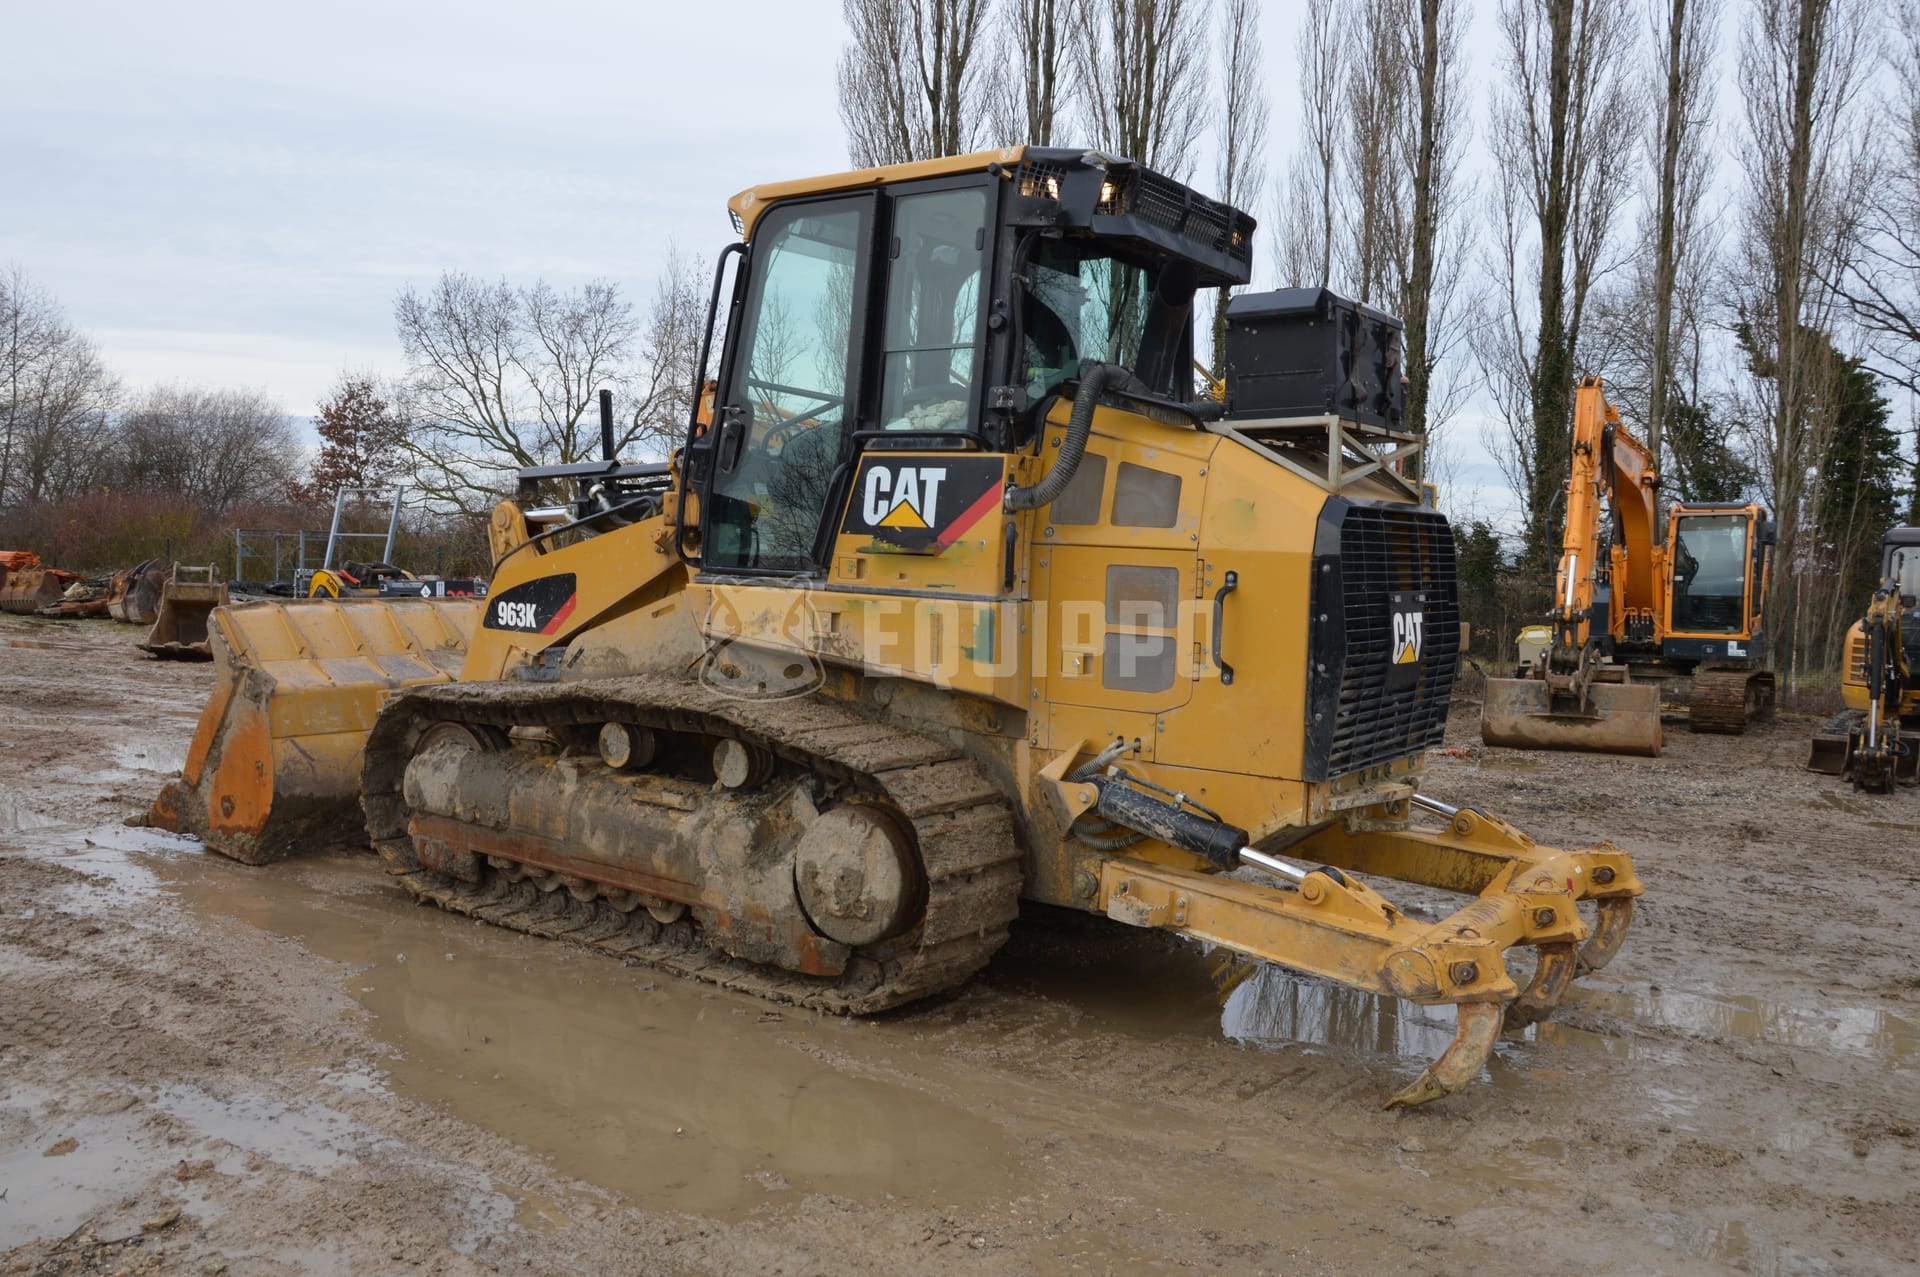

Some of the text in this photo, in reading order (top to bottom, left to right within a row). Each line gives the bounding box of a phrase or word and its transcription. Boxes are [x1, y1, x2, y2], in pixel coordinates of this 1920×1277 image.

[863, 466, 947, 528] CAT
[498, 601, 537, 628] 963K
[1393, 612, 1422, 664] CAT
